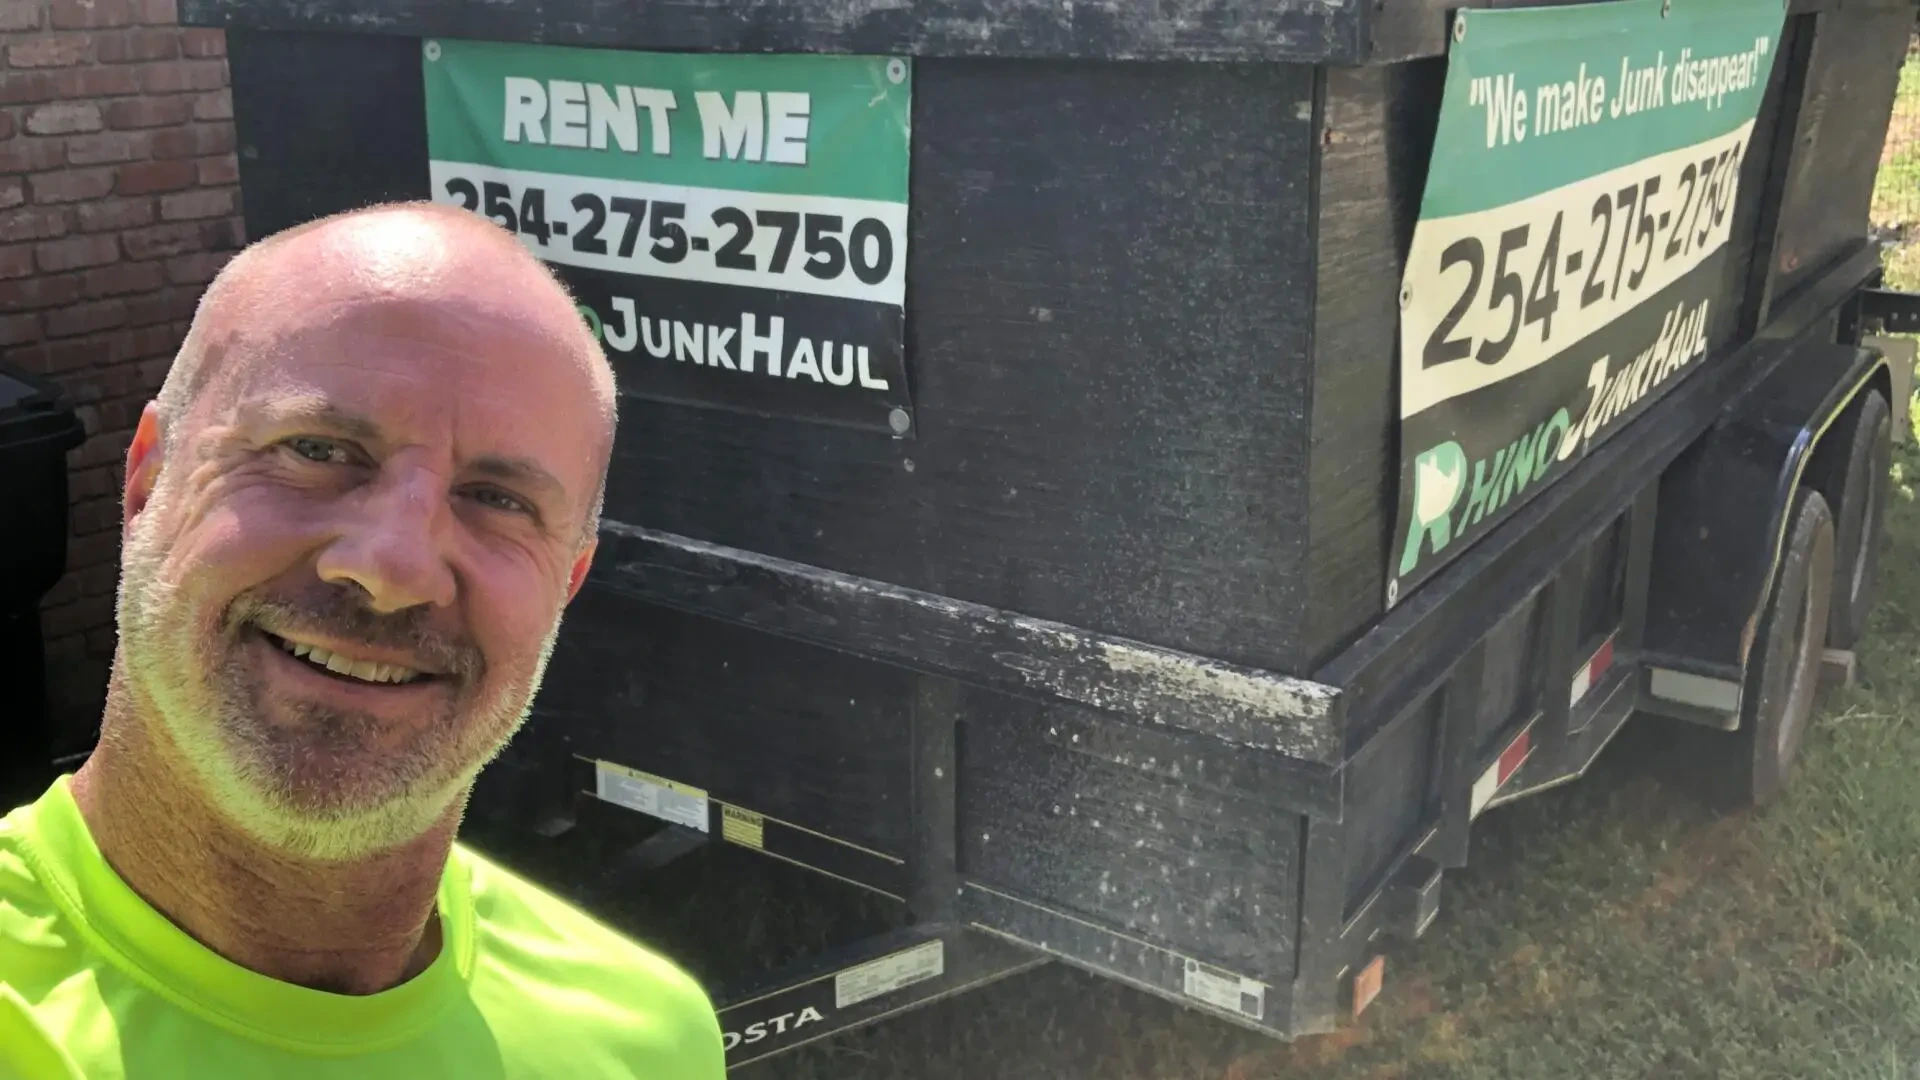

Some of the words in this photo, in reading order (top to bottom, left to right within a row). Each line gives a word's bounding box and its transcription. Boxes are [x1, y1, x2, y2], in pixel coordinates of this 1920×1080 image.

[503, 76, 677, 156] RENT
[694, 90, 811, 166] ME
[1470, 73, 1528, 149] "We
[1534, 62, 1605, 137] make
[1610, 51, 1668, 119] Junk
[1671, 36, 1770, 112] disappear!"
[1422, 139, 1741, 371] 254-275-2750
